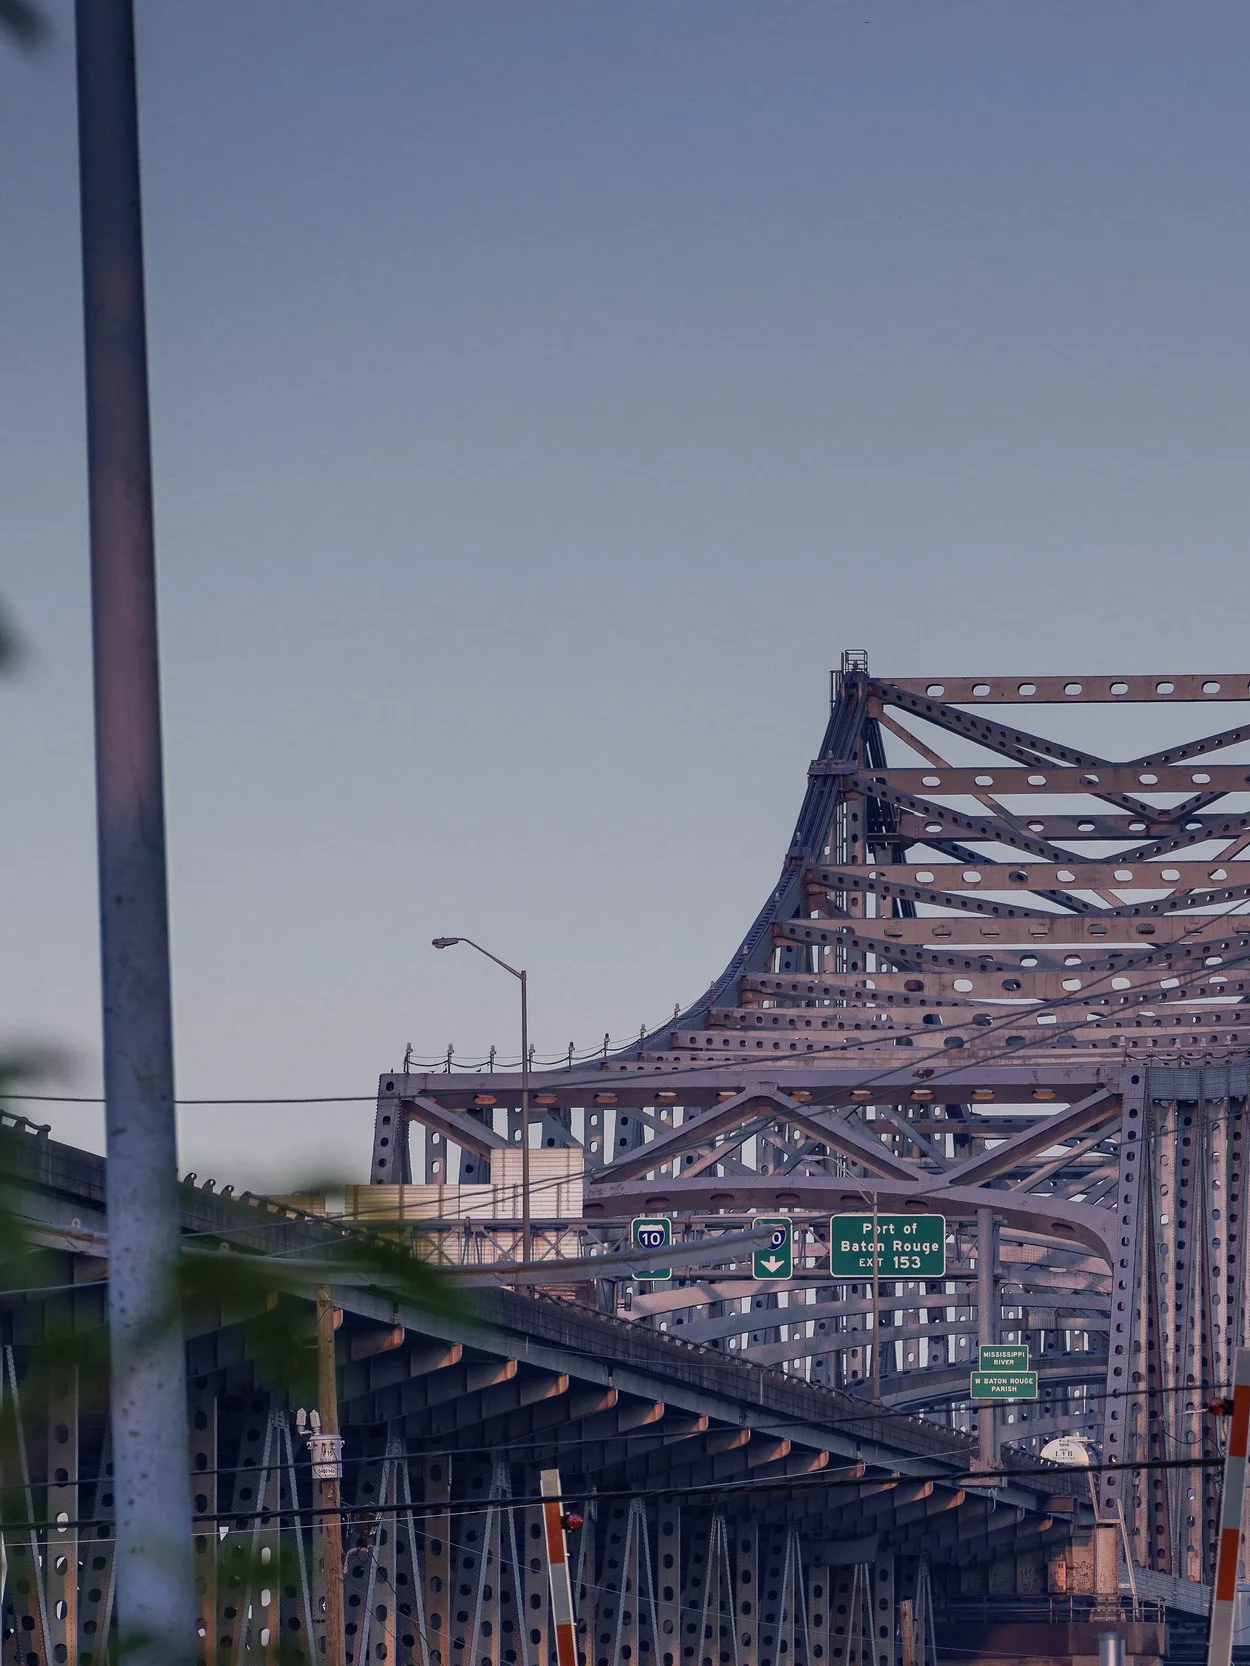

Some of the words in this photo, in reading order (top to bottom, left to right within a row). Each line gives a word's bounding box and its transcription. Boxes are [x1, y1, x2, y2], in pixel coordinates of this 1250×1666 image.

[862, 1222, 895, 1235] Port
[903, 1222, 918, 1235] of
[642, 1232, 661, 1246] 10
[771, 1231, 782, 1245] 0
[841, 1240, 885, 1252] Baton
[893, 1240, 939, 1255] Rouge
[859, 1257, 884, 1267] EXT
[893, 1255, 921, 1269] 153
